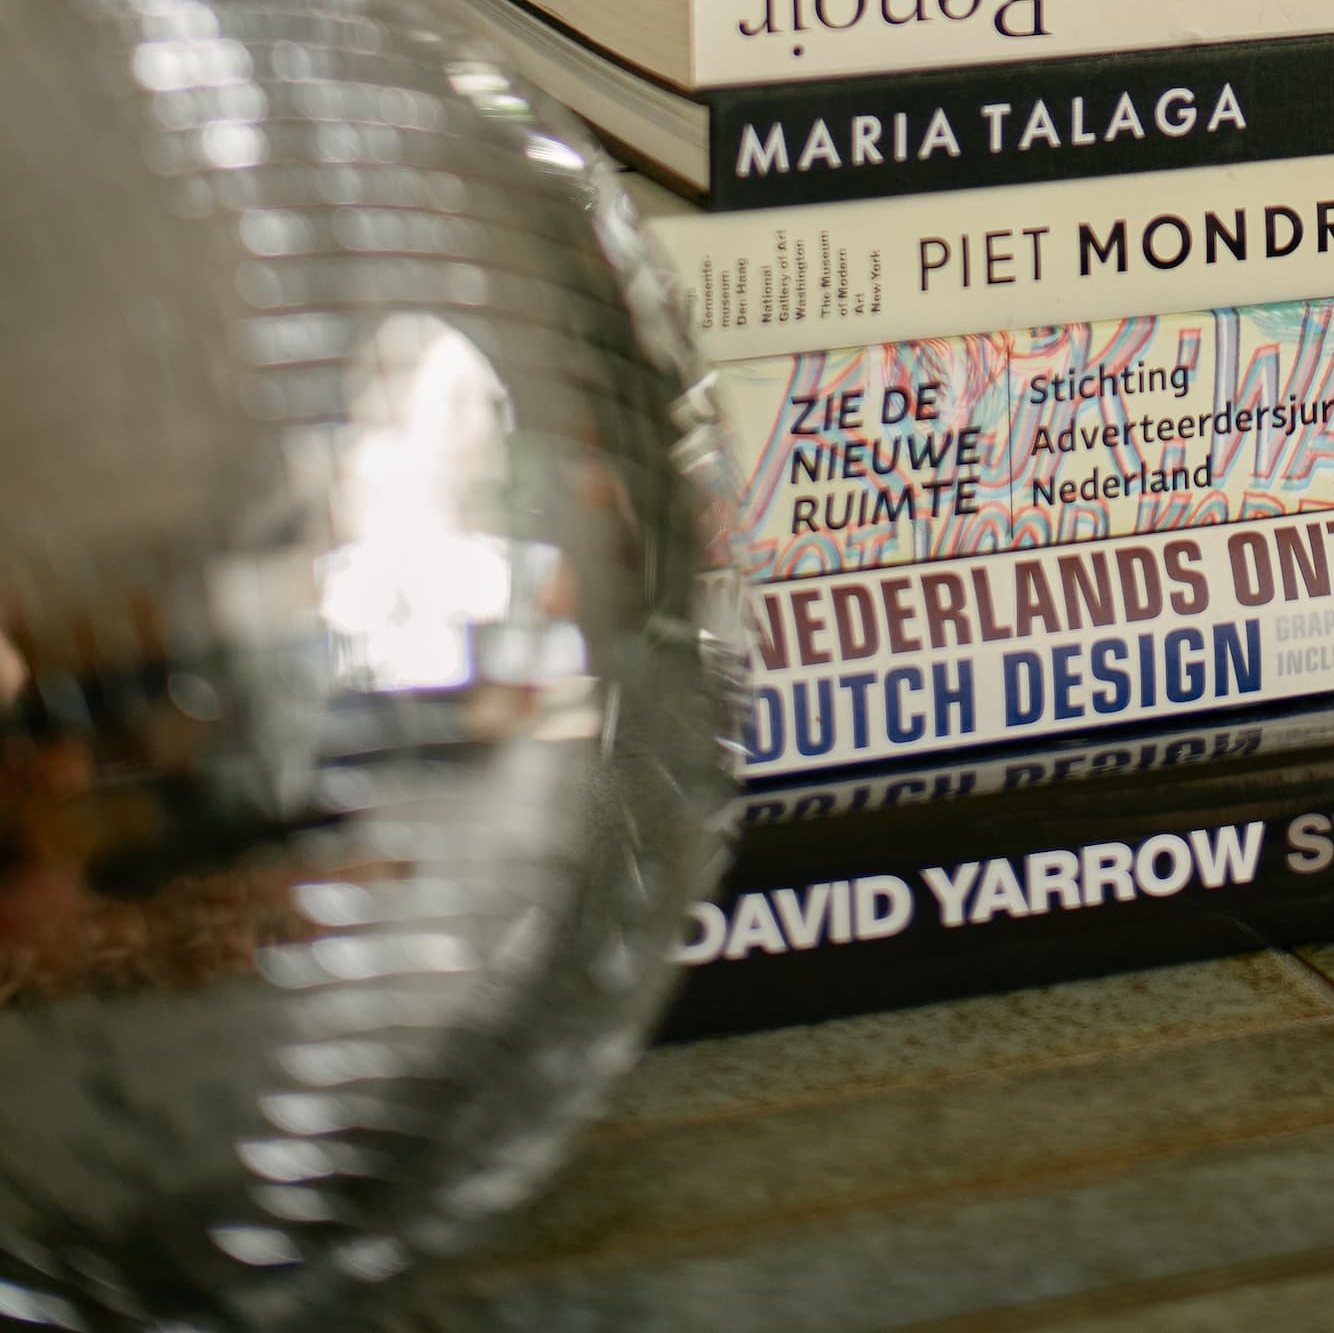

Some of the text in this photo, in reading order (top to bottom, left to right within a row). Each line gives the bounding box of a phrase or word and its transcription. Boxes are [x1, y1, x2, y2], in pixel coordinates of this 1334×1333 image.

[736, 81, 1247, 179] MARIA TALAGA
[737, 257, 748, 326] Den Haag
[776, 230, 791, 322] Gallery of Art
[795, 239, 808, 321] Washington
[820, 230, 831, 319] The Museum
[837, 248, 848, 316] of Modern
[870, 249, 881, 313] New York
[919, 225, 1050, 292] PIET
[721, 269, 730, 328] museum
[761, 265, 773, 323] National
[854, 293, 865, 315] Art
[790, 381, 940, 435] ZIE DE
[1029, 361, 1190, 405] Stichting
[790, 426, 982, 485] NIEUWE
[1032, 455, 1213, 508] Nederland
[791, 475, 981, 534] RUIMTE
[744, 538, 1210, 671] NEDERLANDS
[741, 617, 1263, 765] DUTCH DESIGN
[664, 873, 915, 966] DAVID
[922, 820, 1265, 930] YARROW
